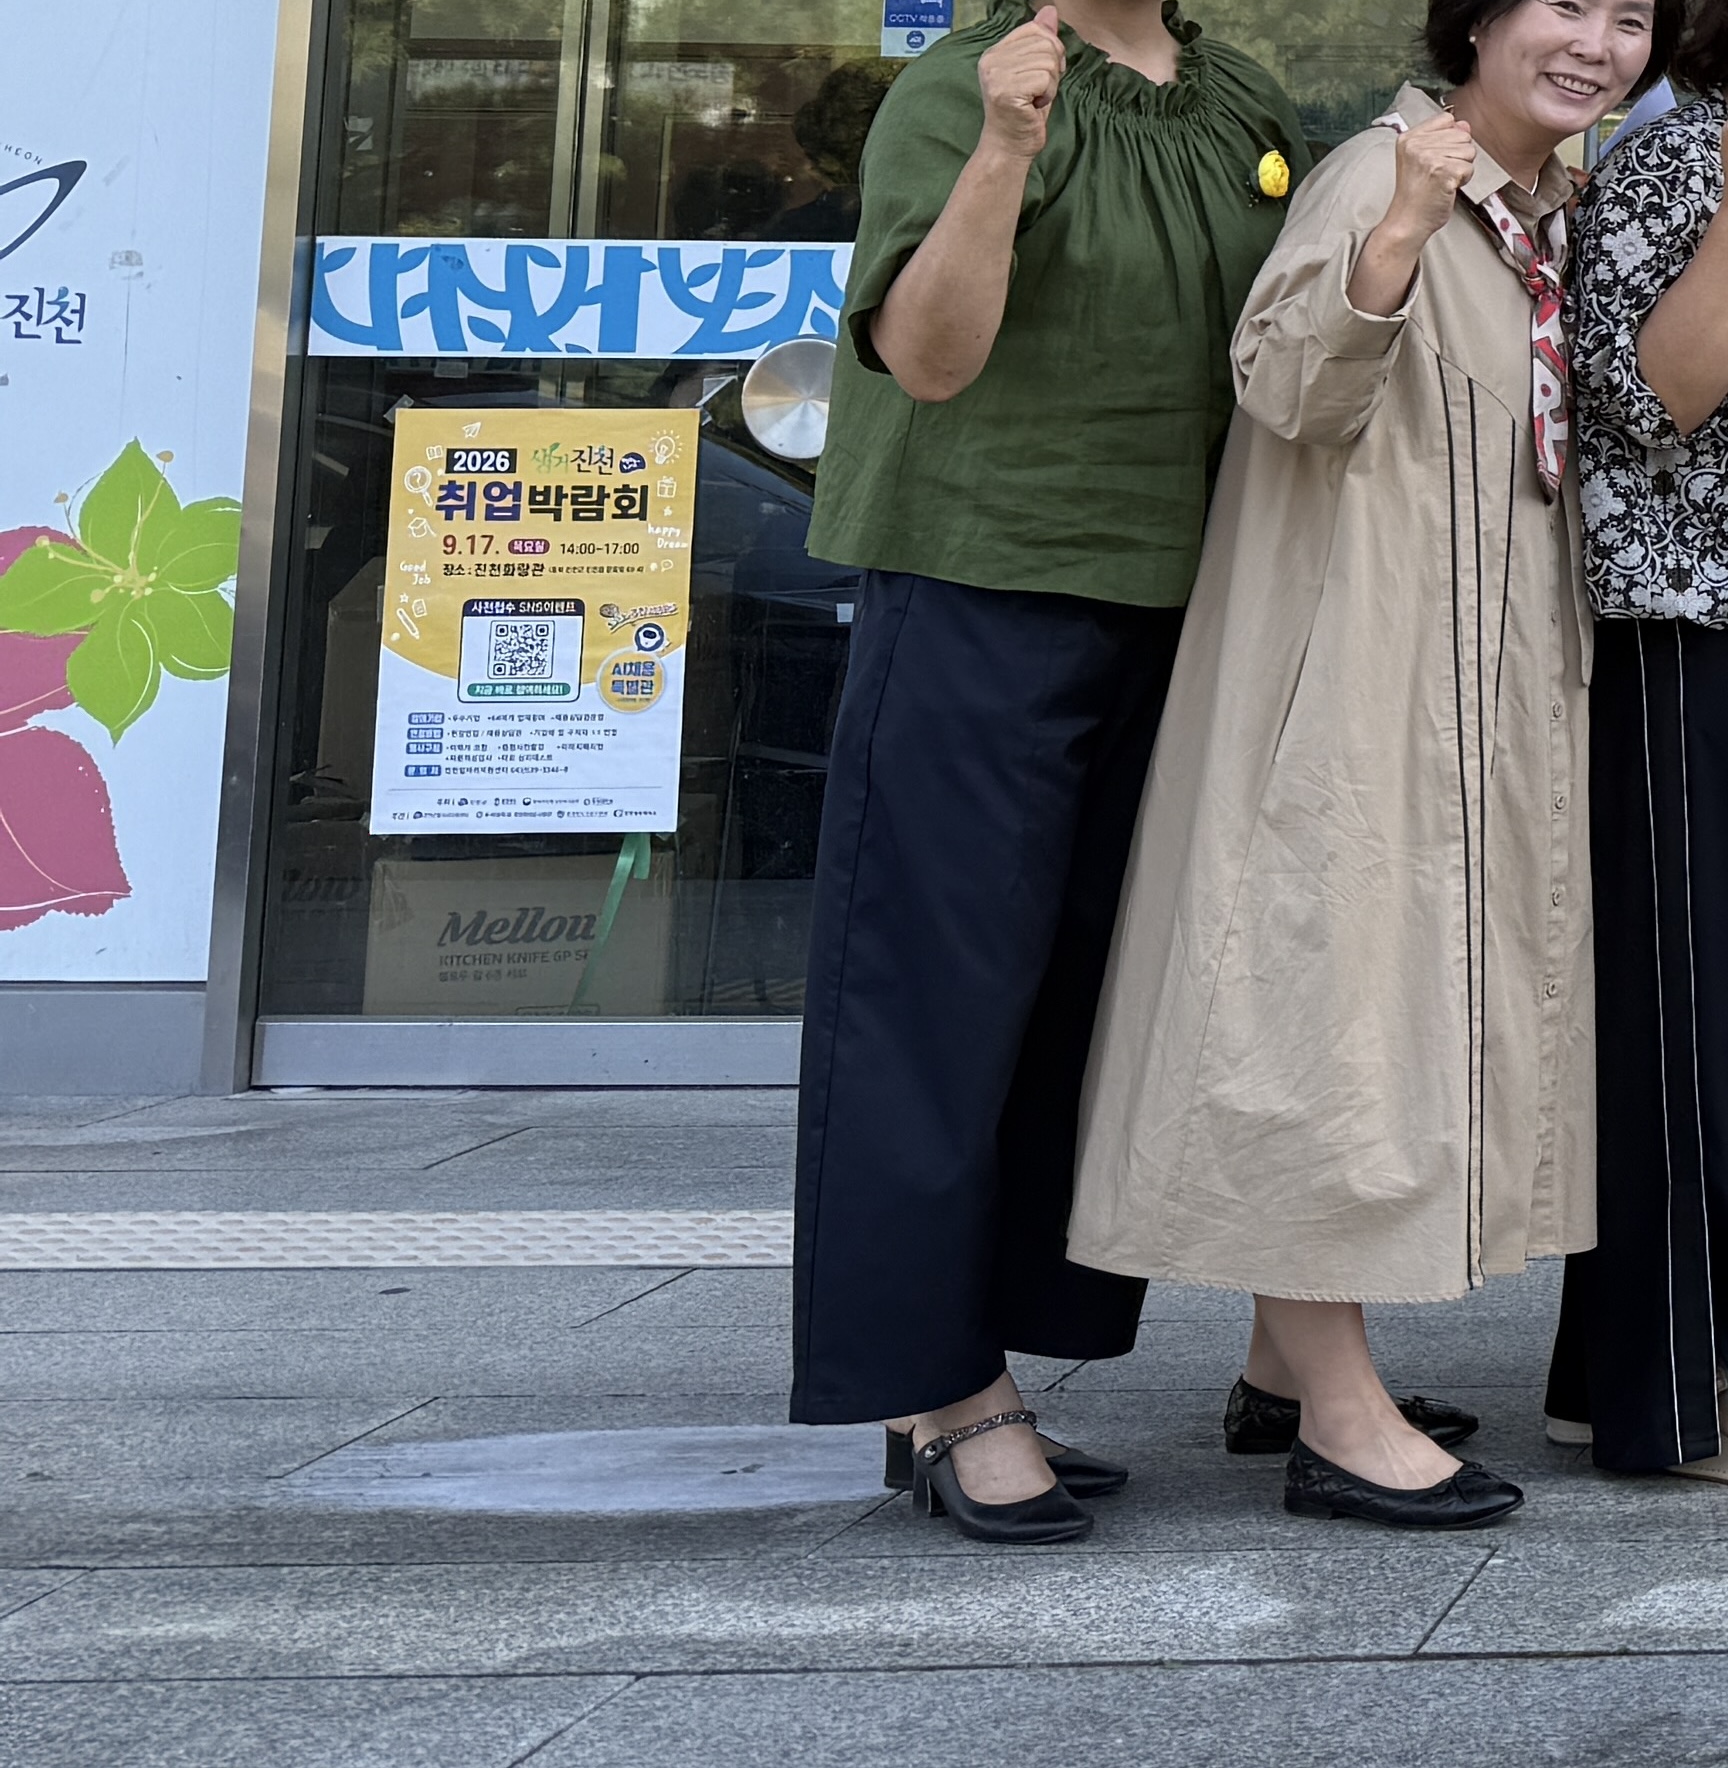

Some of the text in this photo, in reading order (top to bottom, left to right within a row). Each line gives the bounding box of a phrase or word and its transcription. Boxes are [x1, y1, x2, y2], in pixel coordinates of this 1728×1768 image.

[889, 13, 918, 24] CCTV
[0, 285, 87, 345] 진천
[452, 450, 511, 472] 2026
[434, 479, 650, 523] 취업박람회
[442, 534, 500, 556] 9.17.
[439, 952, 503, 967] KITCHEN
[506, 950, 551, 965] KNIFE
